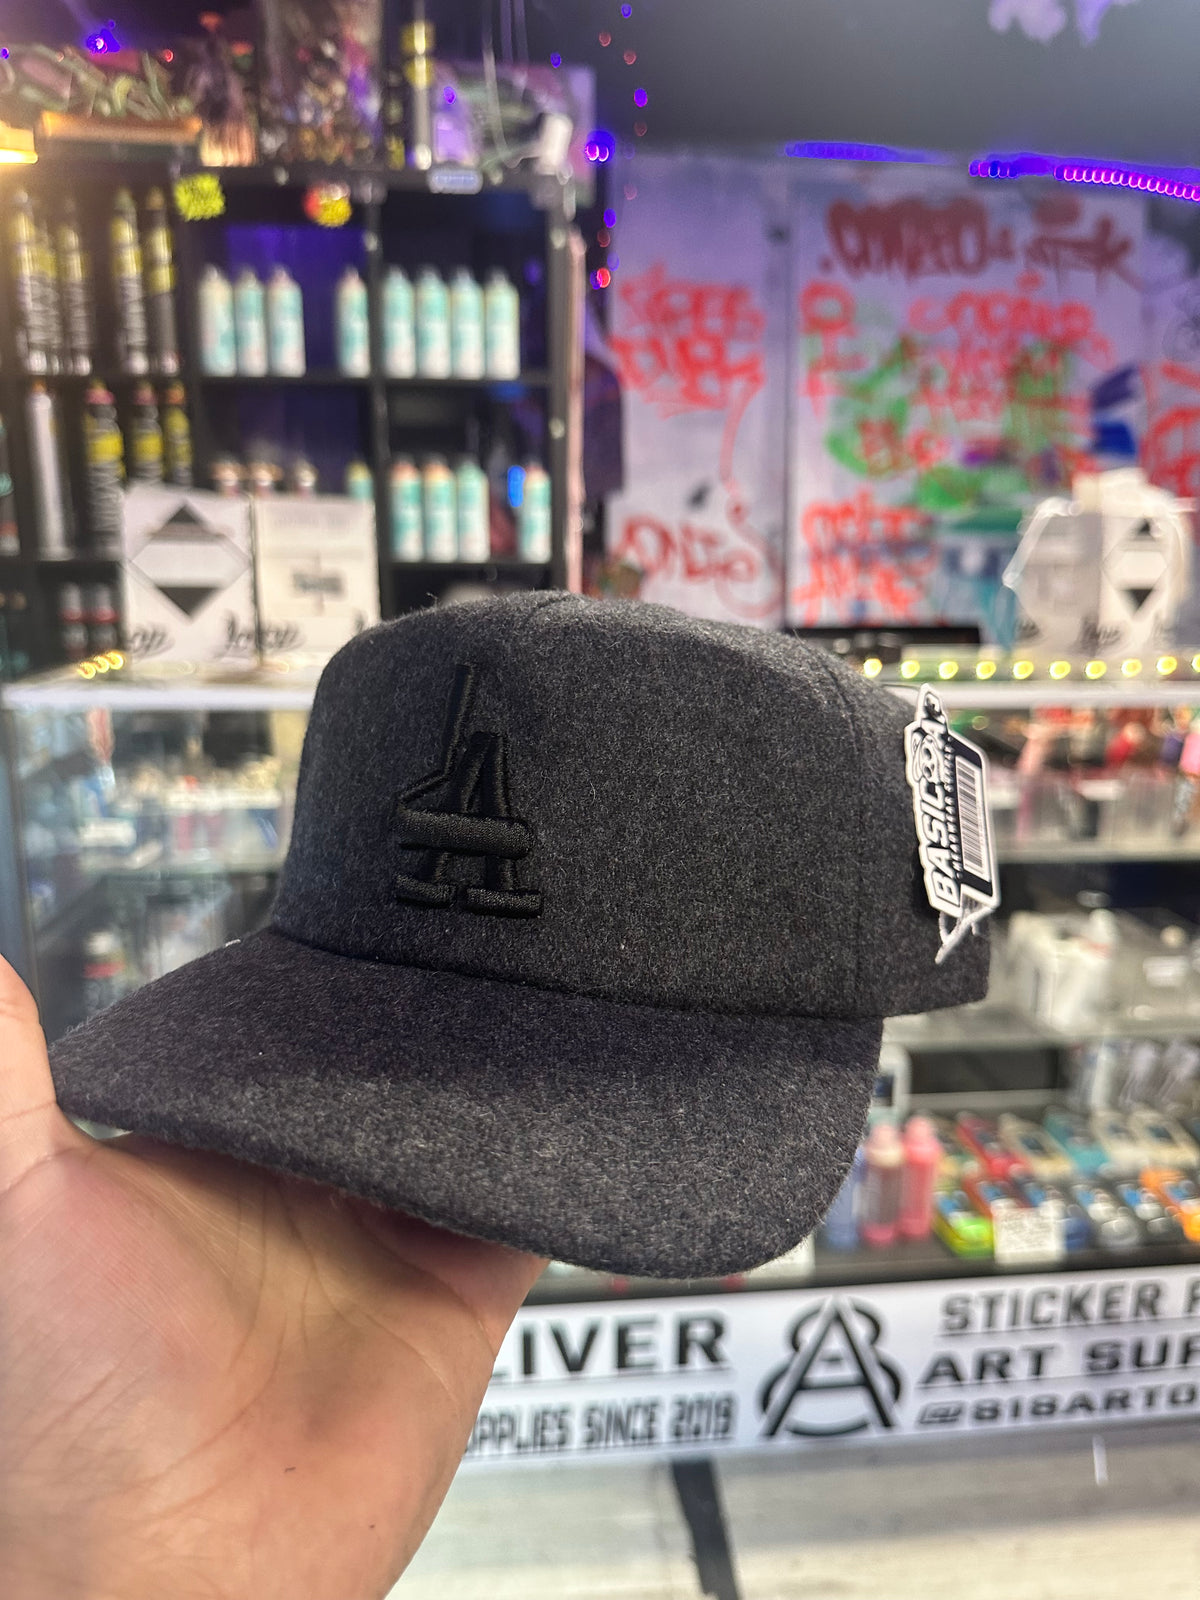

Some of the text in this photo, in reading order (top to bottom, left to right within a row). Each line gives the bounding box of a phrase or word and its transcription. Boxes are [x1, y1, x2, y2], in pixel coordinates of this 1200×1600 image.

[919, 780, 961, 908] BASIC
[943, 1281, 1161, 1330] STICKER
[492, 1310, 730, 1380] IVER
[919, 1343, 1055, 1384] ART
[584, 1399, 658, 1443] SINCE
